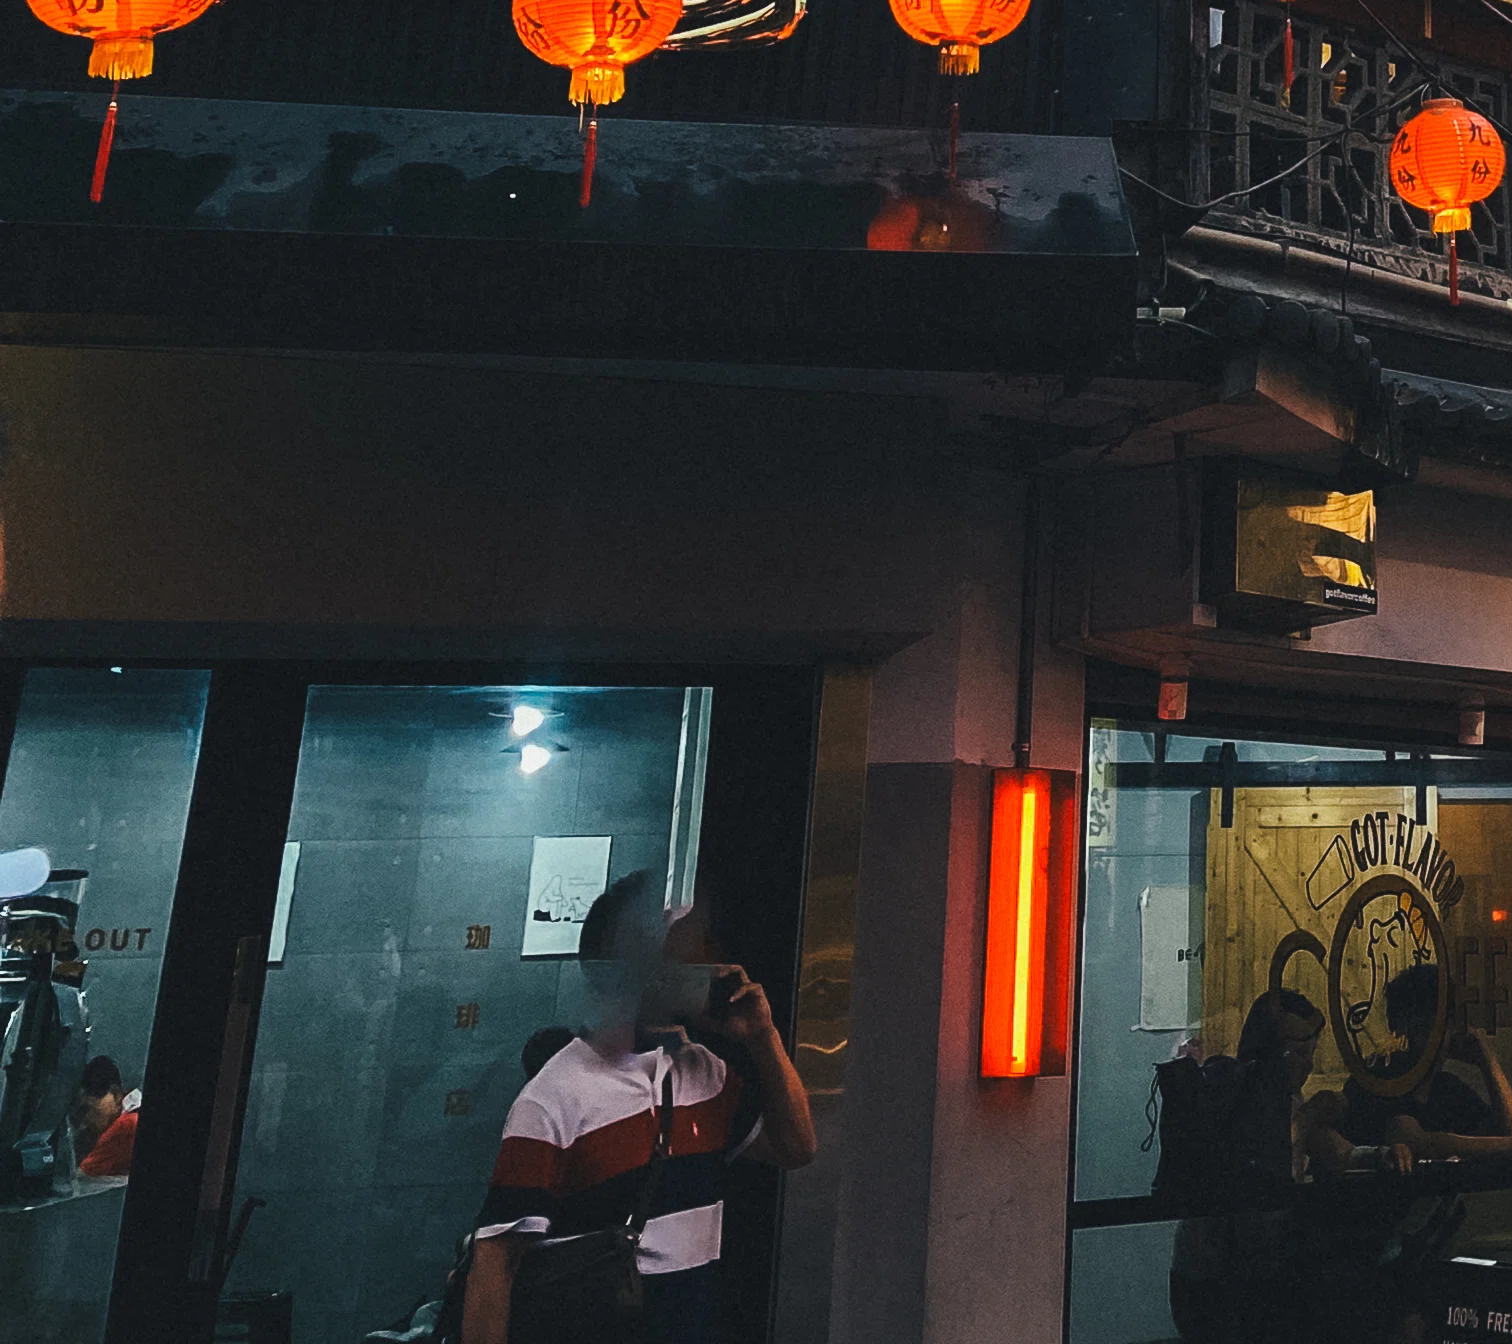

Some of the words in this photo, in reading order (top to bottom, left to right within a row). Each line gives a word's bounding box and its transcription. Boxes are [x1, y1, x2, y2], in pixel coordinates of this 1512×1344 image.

[1469, 118, 1493, 186] 九份
[84, 927, 153, 952] OUT
[1447, 1306, 1479, 1328] 100%
